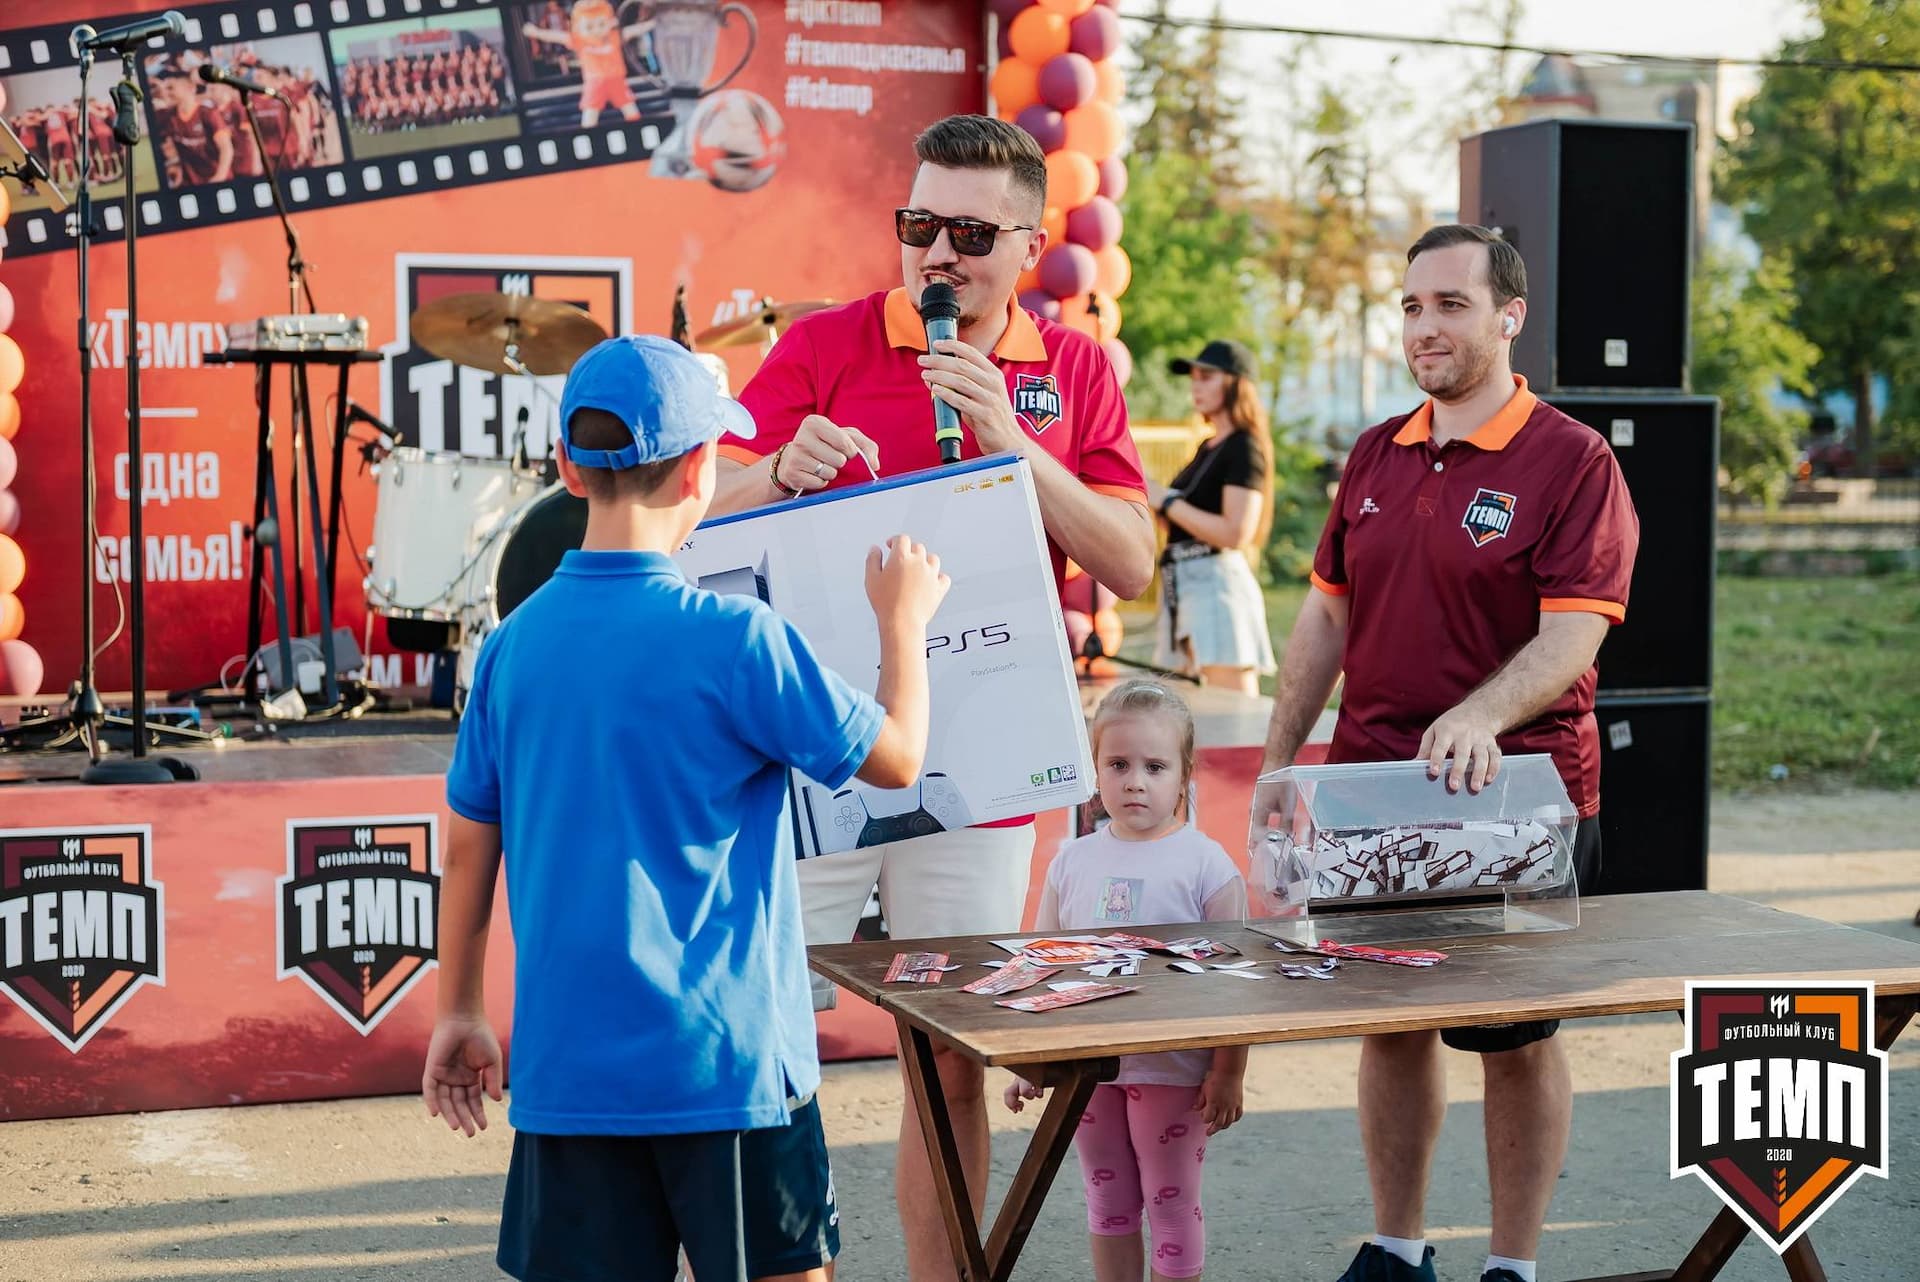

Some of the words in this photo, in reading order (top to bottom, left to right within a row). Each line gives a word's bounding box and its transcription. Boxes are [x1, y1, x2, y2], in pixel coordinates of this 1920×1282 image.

[408, 358, 568, 460] ТЕМ
[1019, 390, 1058, 414] ТЕМП
[114, 451, 219, 506] одна
[1469, 505, 1509, 531] ТЕМП
[926, 623, 1011, 659] PS5
[24, 860, 91, 880] ФУТБОЛЬНЫЙ
[93, 862, 120, 877] КЛУБ
[318, 849, 380, 869] ФУТБОЛЬНЫЙ
[383, 851, 408, 866] КЛУБ
[0, 889, 147, 969] ТЕМП
[294, 877, 433, 955] ТЕМП
[62, 964, 86, 977] 2020
